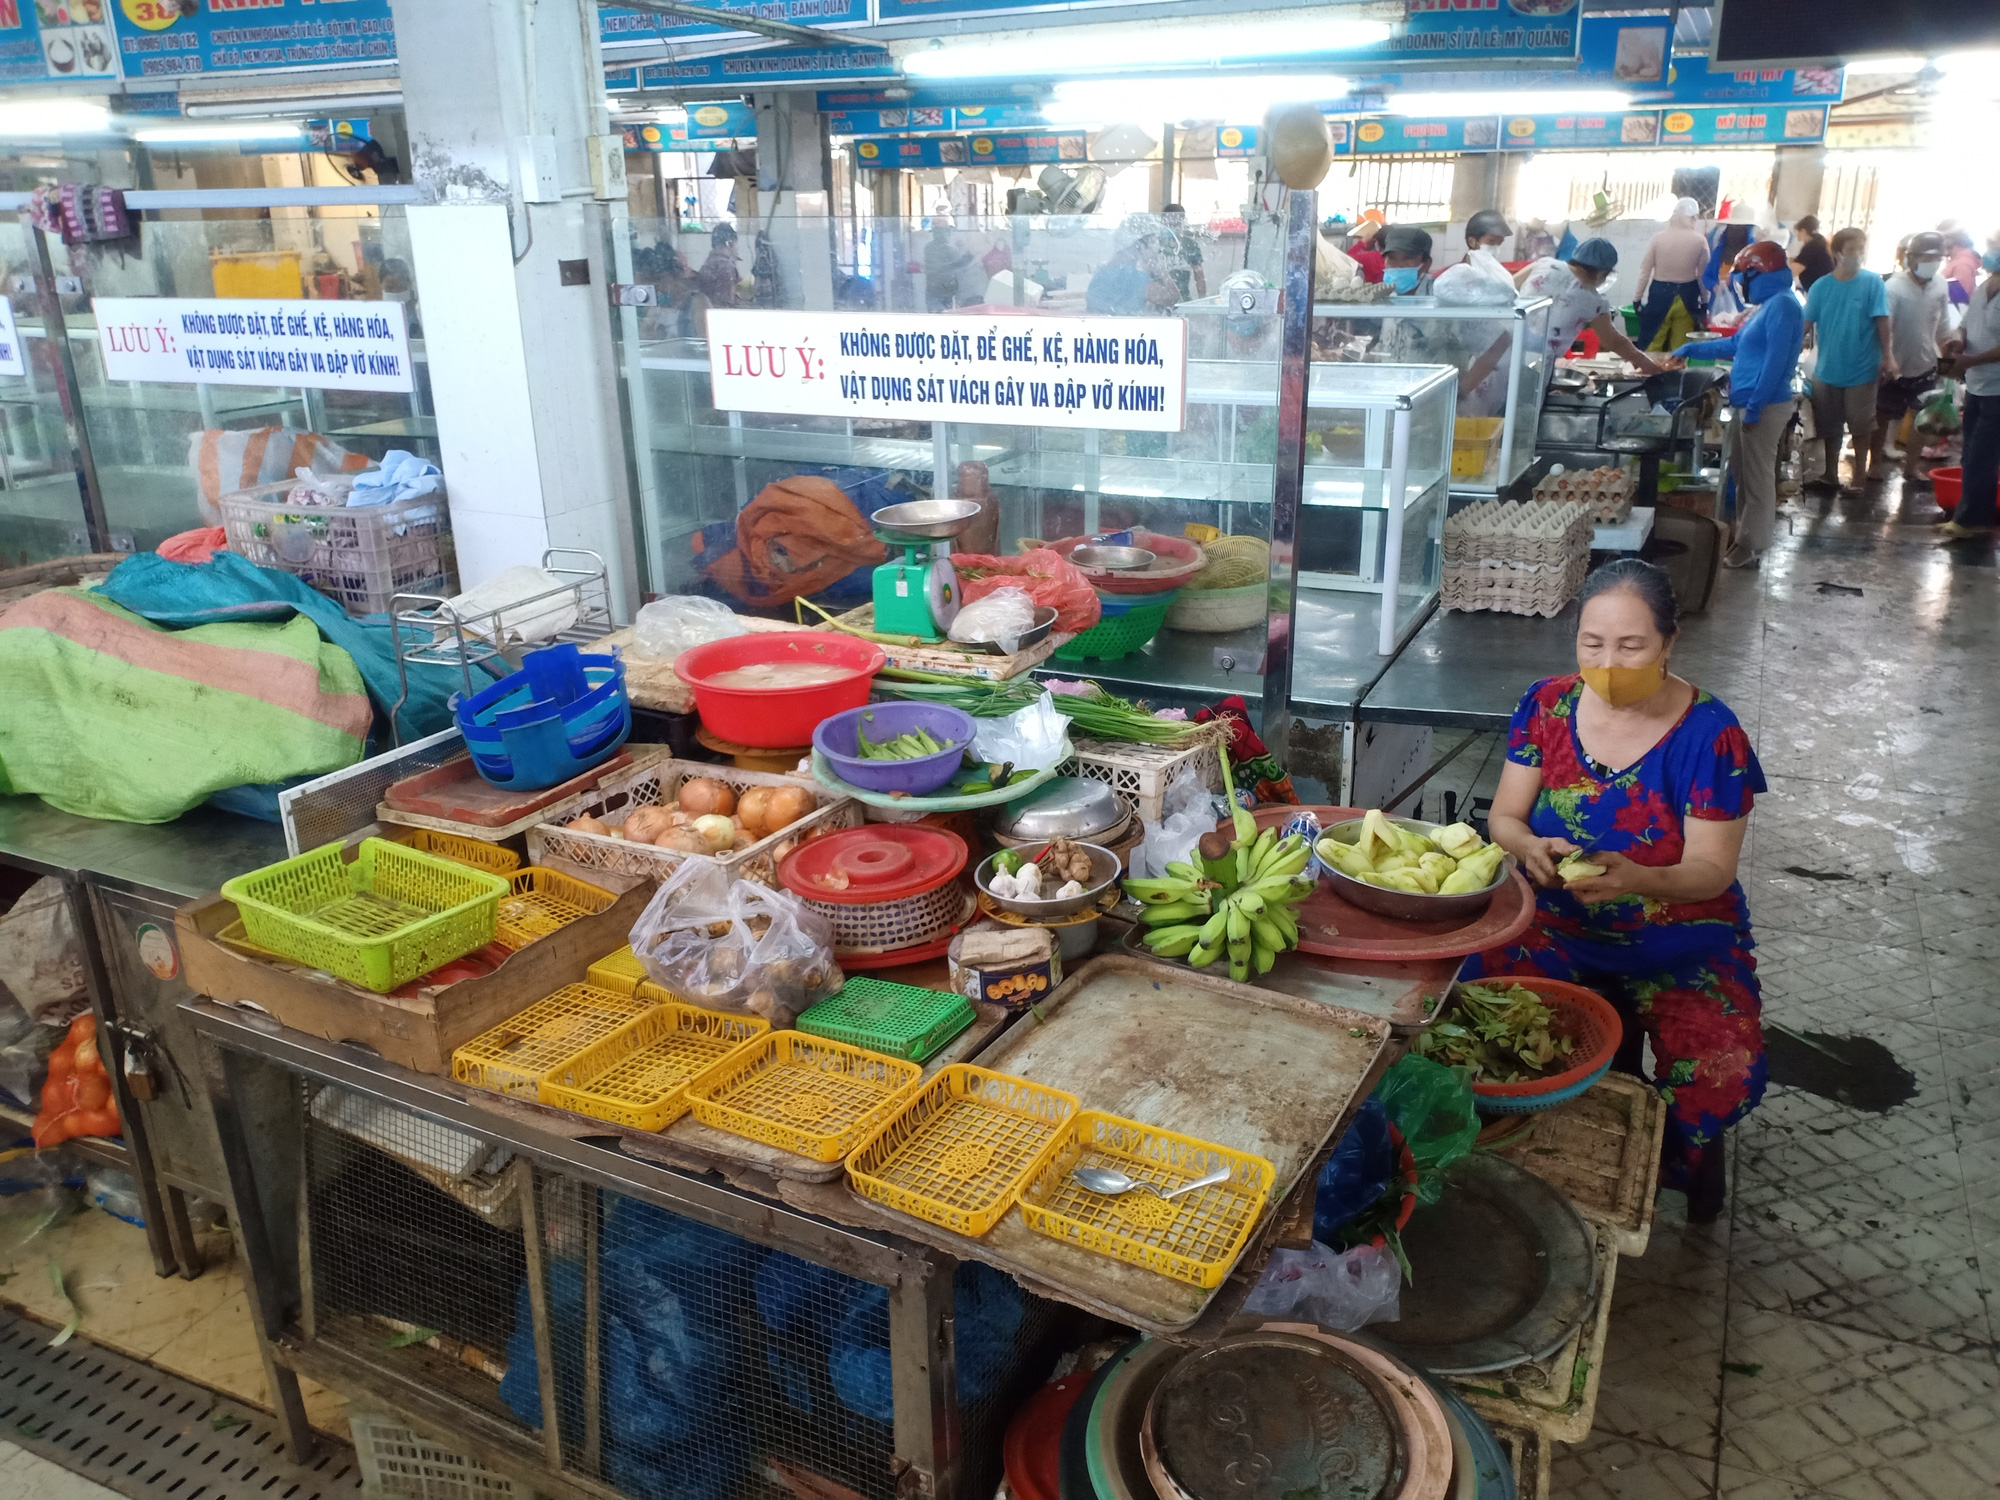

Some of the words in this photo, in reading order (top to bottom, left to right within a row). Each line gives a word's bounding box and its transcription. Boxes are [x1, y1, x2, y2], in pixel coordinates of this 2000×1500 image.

[1406, 31, 1446, 50] DOANH
[1526, 24, 1570, 48] QUẢNG
[758, 57, 778, 73] KINH
[781, 56, 810, 72] DOANH
[1737, 114, 1766, 128] LINH
[107, 322, 150, 353] LƯU
[154, 318, 177, 354] Ý:
[181, 311, 217, 334] KHÔNG
[217, 312, 246, 339] ĐƯỢC
[247, 310, 270, 340] ĐẶT,
[271, 307, 285, 336] ĐỂ
[287, 309, 312, 340] GHẾ,
[313, 312, 333, 342] KỆ,
[333, 312, 365, 338] HÀNG
[366, 313, 394, 342] HÓA,
[186, 345, 206, 373] VẬT
[207, 349, 236, 374] DỤNG
[238, 346, 257, 370] SÁT
[257, 346, 287, 371] VÁCH
[288, 347, 309, 373] GÂY
[310, 352, 326, 373] VA
[327, 349, 348, 379] ĐẬP
[351, 349, 367, 375] VỠ
[368, 350, 401, 376] KÍNH!
[722, 340, 787, 378] LƯU
[795, 336, 825, 380] Ý:
[840, 327, 891, 358] KHÔNG
[895, 331, 936, 364] ĐƯỢC
[940, 329, 972, 365] ĐẶT,
[977, 325, 998, 361] ĐỂ
[1002, 328, 1038, 366] GHẾ,
[1043, 332, 1068, 369] KỆ,
[1074, 332, 1119, 365] HÀNG
[1124, 333, 1164, 369] HÓA,
[840, 370, 867, 405] VẬT
[872, 376, 912, 406] DỤNG
[917, 373, 944, 403] SÁT
[949, 374, 989, 405] VÁCH
[995, 376, 1025, 407] GÂY
[1030, 381, 1049, 408] VA
[1054, 378, 1086, 414] ĐẬP
[1092, 378, 1114, 411] VỠ
[1118, 380, 1165, 412] KÍNH!
